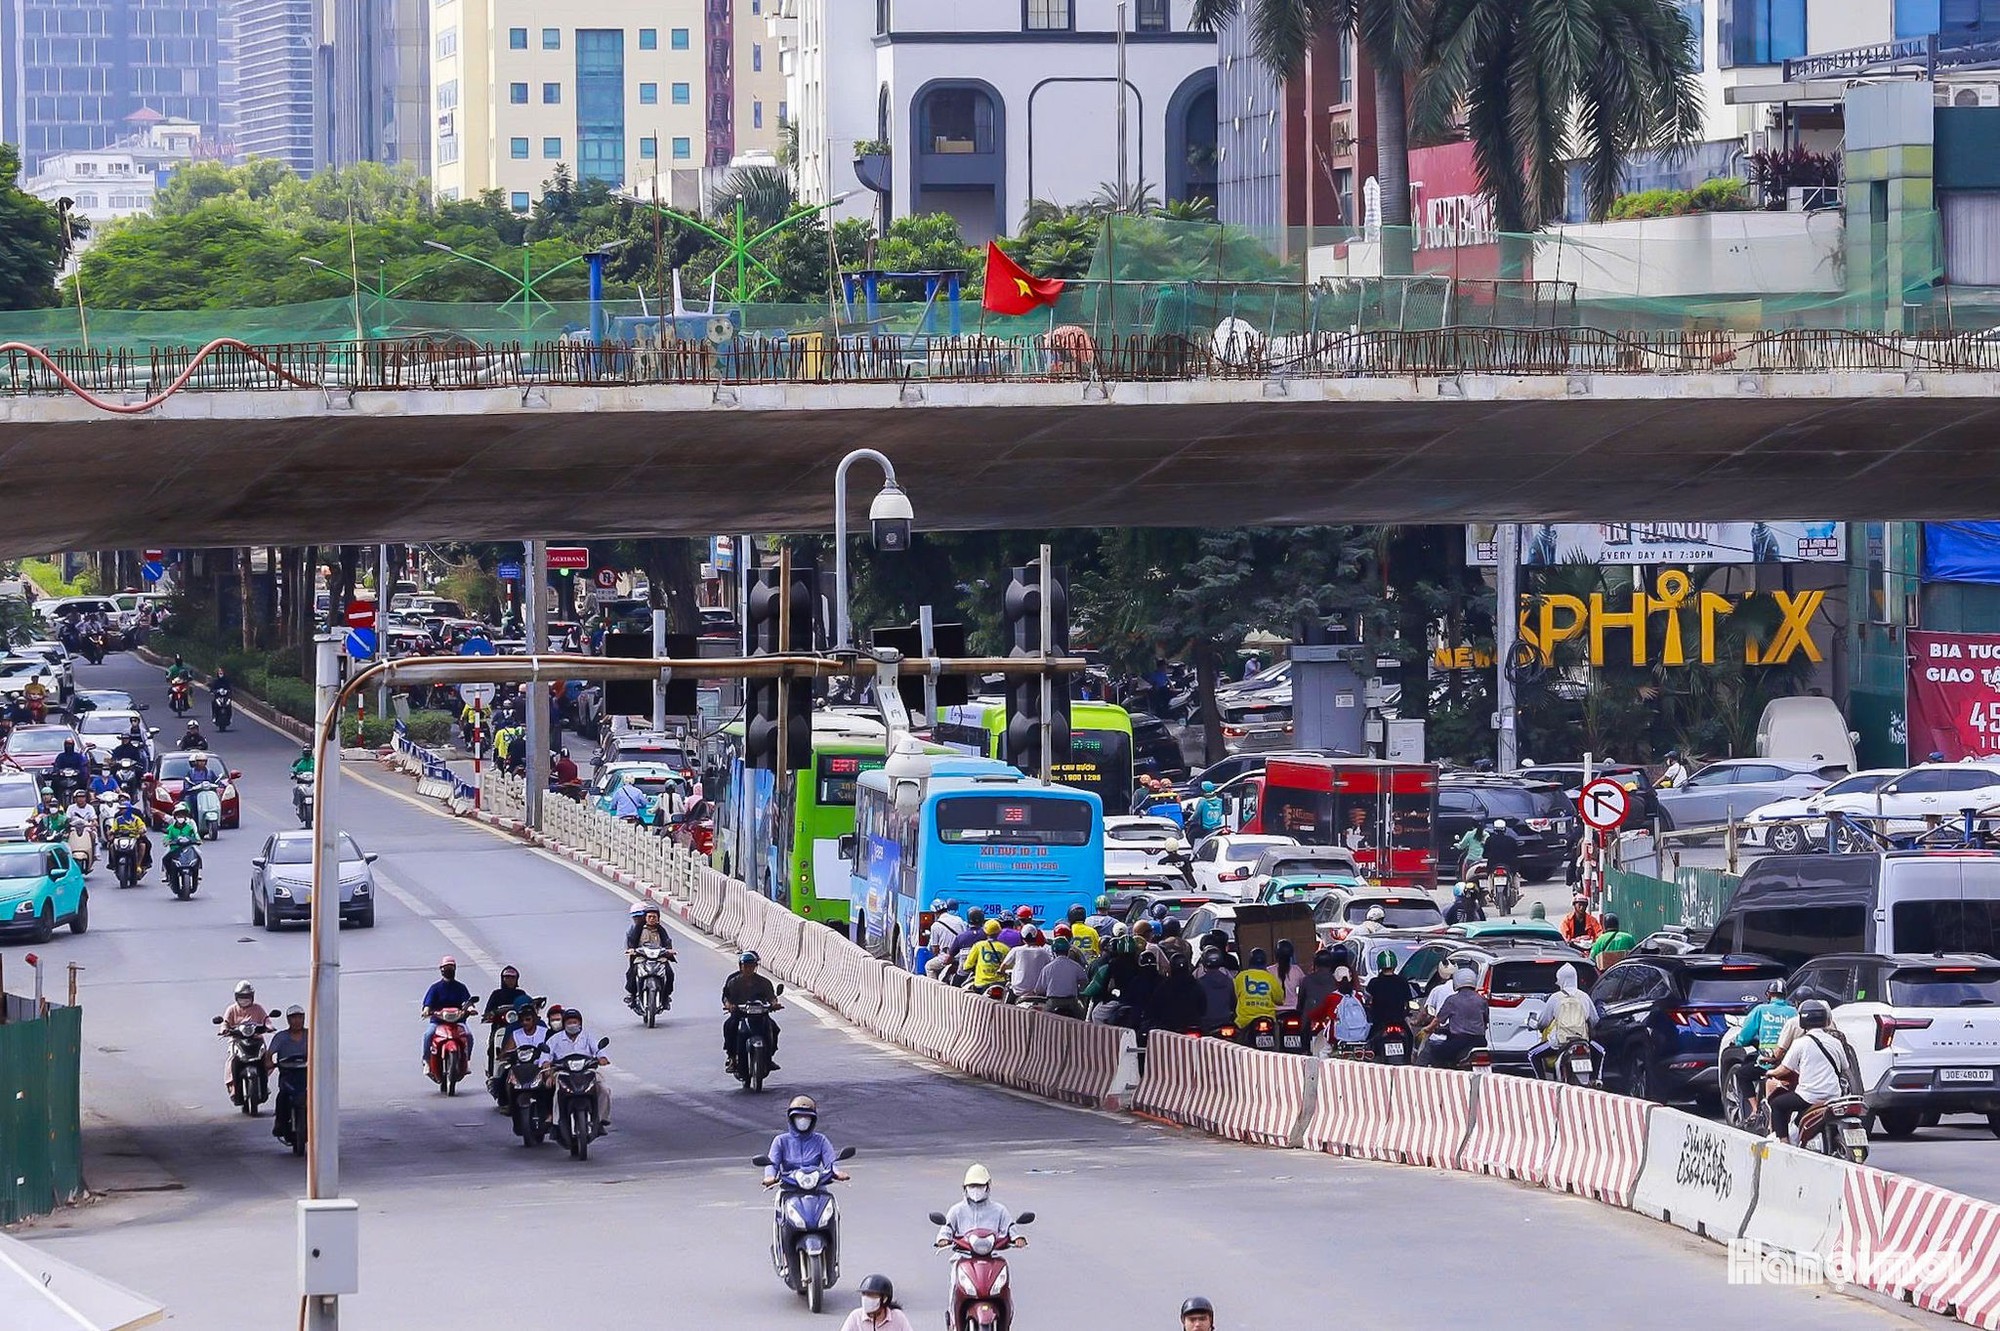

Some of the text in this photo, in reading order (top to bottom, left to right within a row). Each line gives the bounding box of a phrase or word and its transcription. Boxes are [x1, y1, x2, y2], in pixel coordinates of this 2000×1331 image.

[1600, 550, 1714, 561] EVERY DAY AT 7:30PM
[1930, 643, 1962, 658] BIA
[1926, 667, 1975, 682] GIAO
[1245, 975, 1271, 996] be
